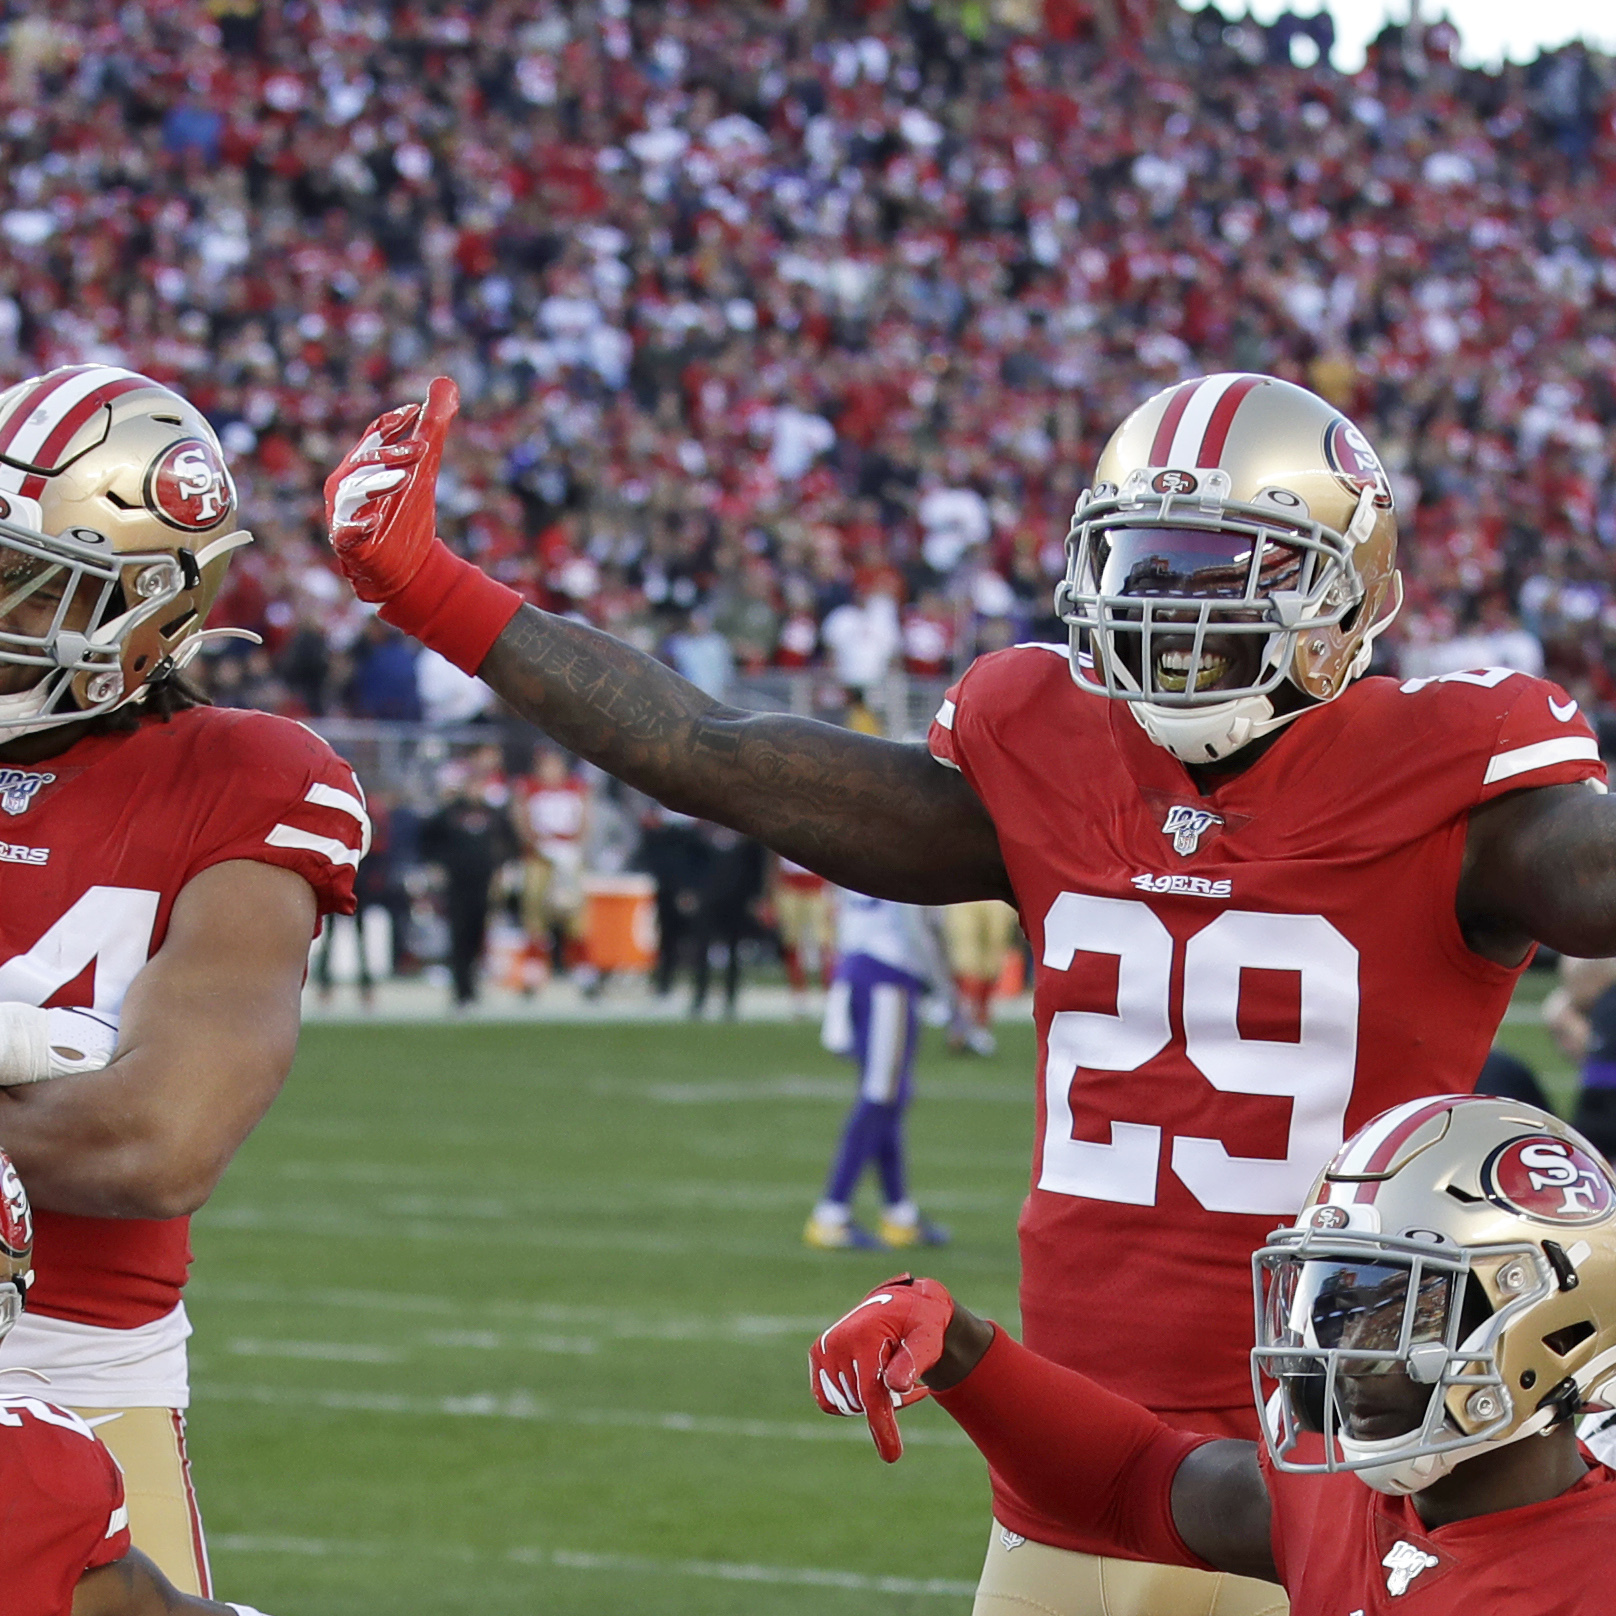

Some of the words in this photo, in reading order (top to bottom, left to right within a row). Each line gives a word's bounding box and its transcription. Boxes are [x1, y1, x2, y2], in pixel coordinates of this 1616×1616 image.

[174, 448, 227, 520] SF
[1129, 873, 1232, 900] 49ERS
[1037, 890, 1360, 1216] 29
[1519, 1144, 1601, 1214] SF
